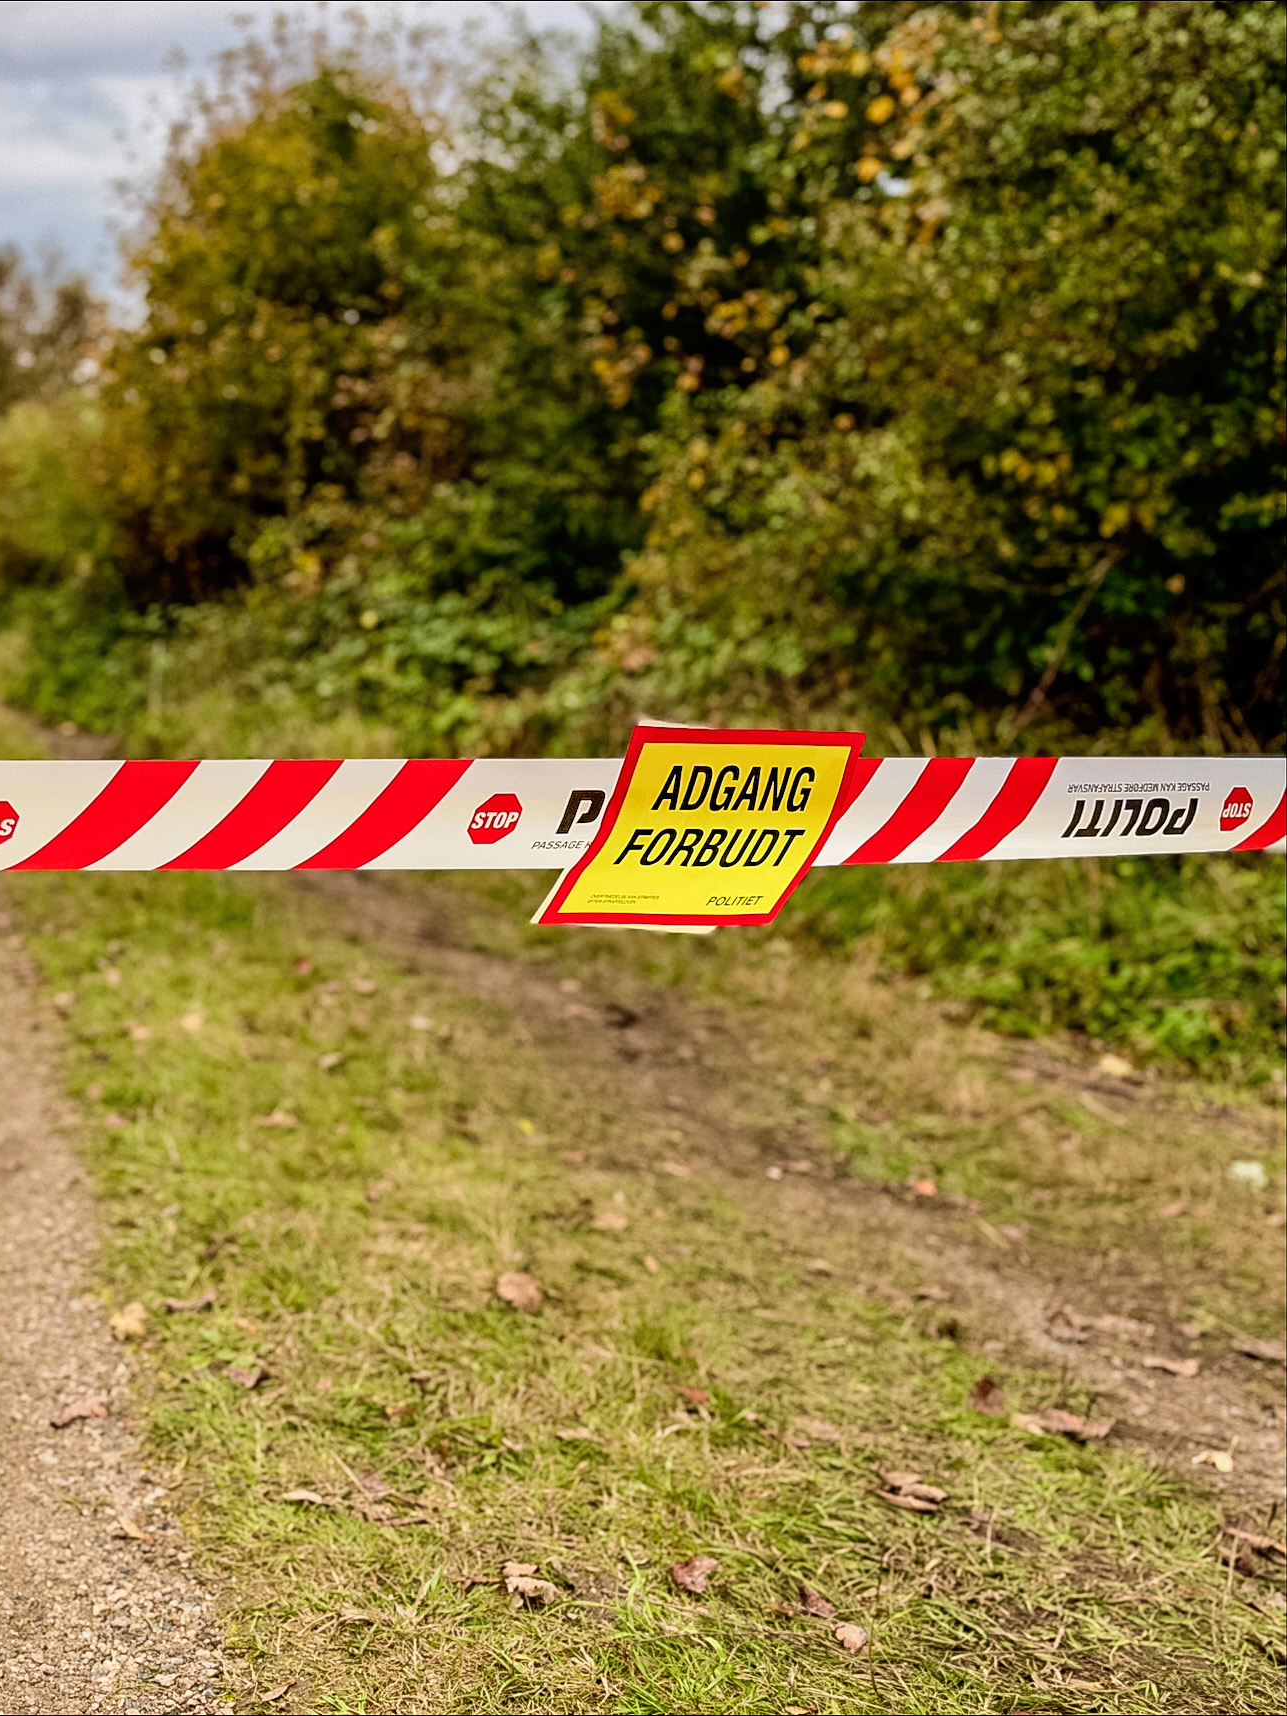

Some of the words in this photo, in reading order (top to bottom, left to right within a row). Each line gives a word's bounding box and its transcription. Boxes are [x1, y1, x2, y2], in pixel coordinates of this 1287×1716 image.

[650, 765, 816, 813] ADGANG
[1067, 782, 1122, 793] STRAFANSVAR
[1124, 782, 1158, 792] MEDFØRE
[1160, 782, 1176, 792] KAN
[1177, 782, 1210, 792] PASSAGE
[1222, 802, 1252, 819] STOP
[470, 811, 520, 829] STOP
[1060, 797, 1199, 839] POLITI
[531, 840, 584, 849] PASSAGE
[612, 828, 807, 868] FORBUDT
[705, 895, 764, 907] POLITIET
